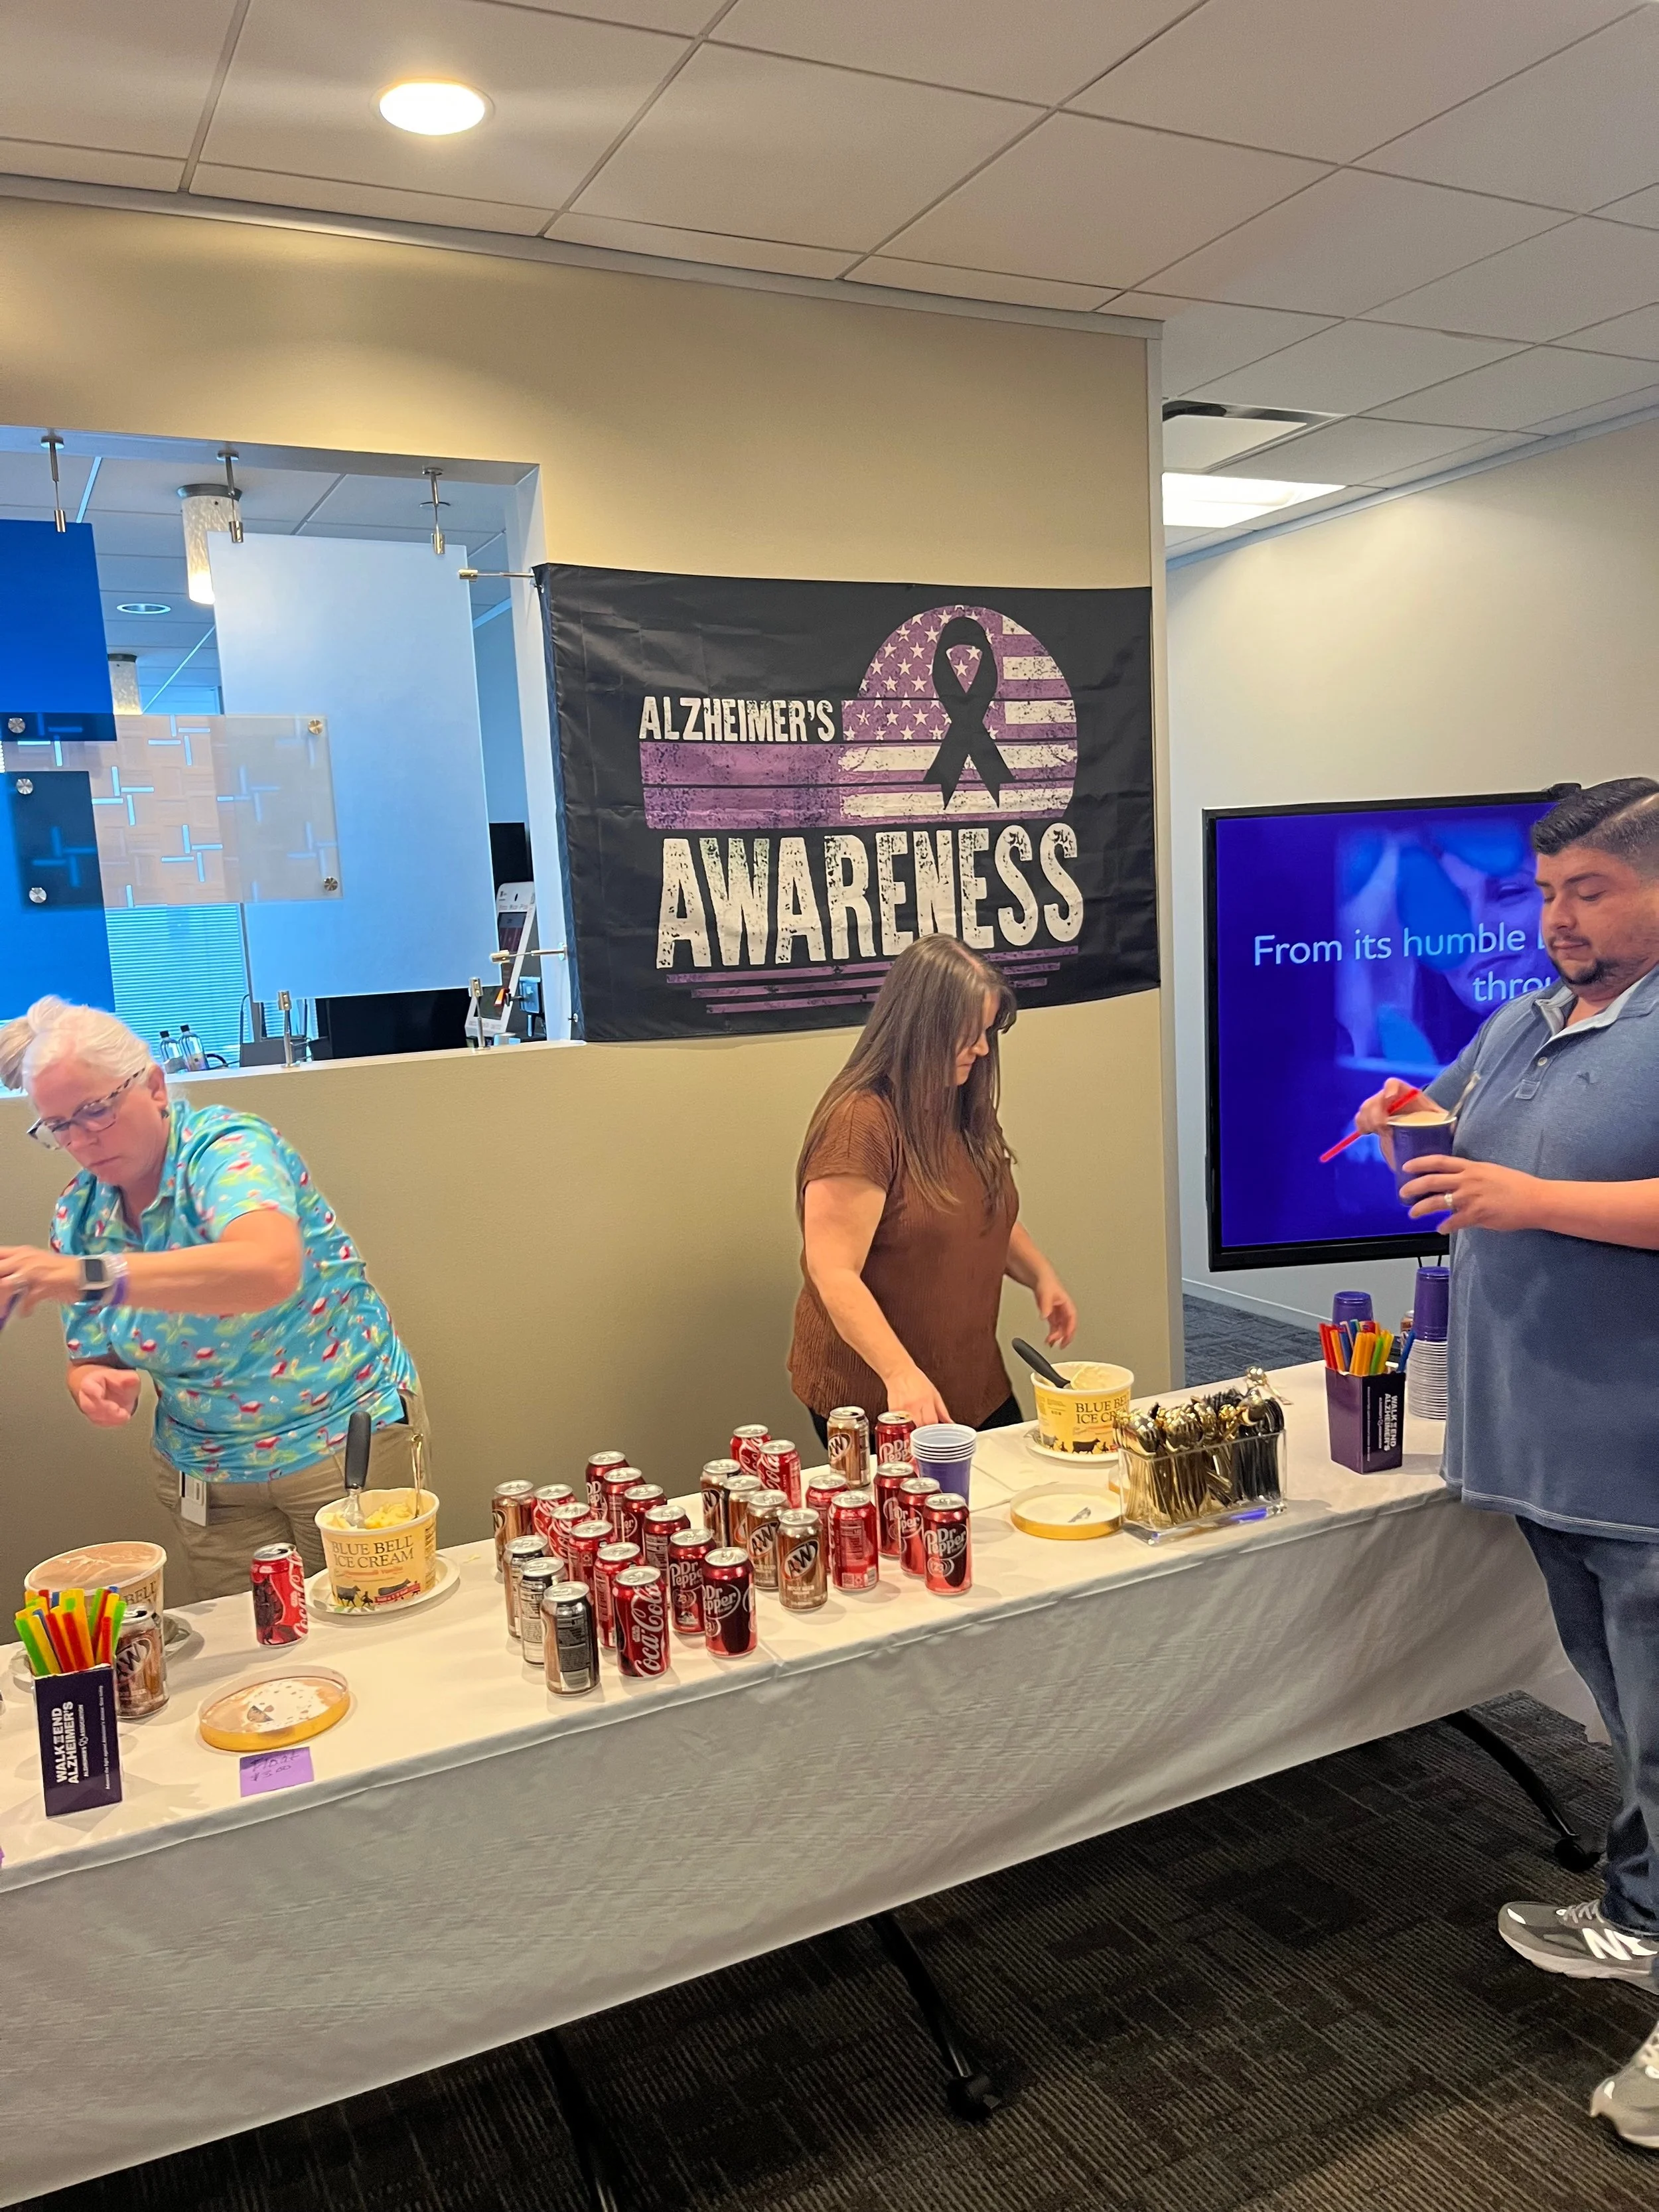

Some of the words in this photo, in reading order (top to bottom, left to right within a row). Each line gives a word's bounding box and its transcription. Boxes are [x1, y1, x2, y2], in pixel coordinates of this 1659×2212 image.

[639, 696, 835, 742] ALZHEIMER'S
[656, 824, 1084, 969] AWARENESS
[1255, 934, 1342, 966] From
[1355, 929, 1392, 960] its
[1404, 922, 1526, 957] humble
[1473, 971, 1551, 1001] thro
[1075, 1401, 1111, 1413] BLUE
[1077, 1414, 1098, 1424] ICE
[331, 1541, 370, 1555] BLUE
[374, 1535, 414, 1554] BELL
[924, 1530, 966, 1556] Pepper
[937, 1528, 956, 1542] Dr
[333, 1554, 355, 1568] ICE
[357, 1548, 414, 1568] CREAM
[680, 1562, 698, 1575] Dr
[669, 1563, 703, 1588] Peppe
[704, 1592, 737, 1615] epper
[705, 1585, 723, 1600] Dr
[52, 1708, 64, 1733] END
[62, 1702, 79, 1784] ALZHEIMER'S
[54, 1746, 67, 1783] WALK
